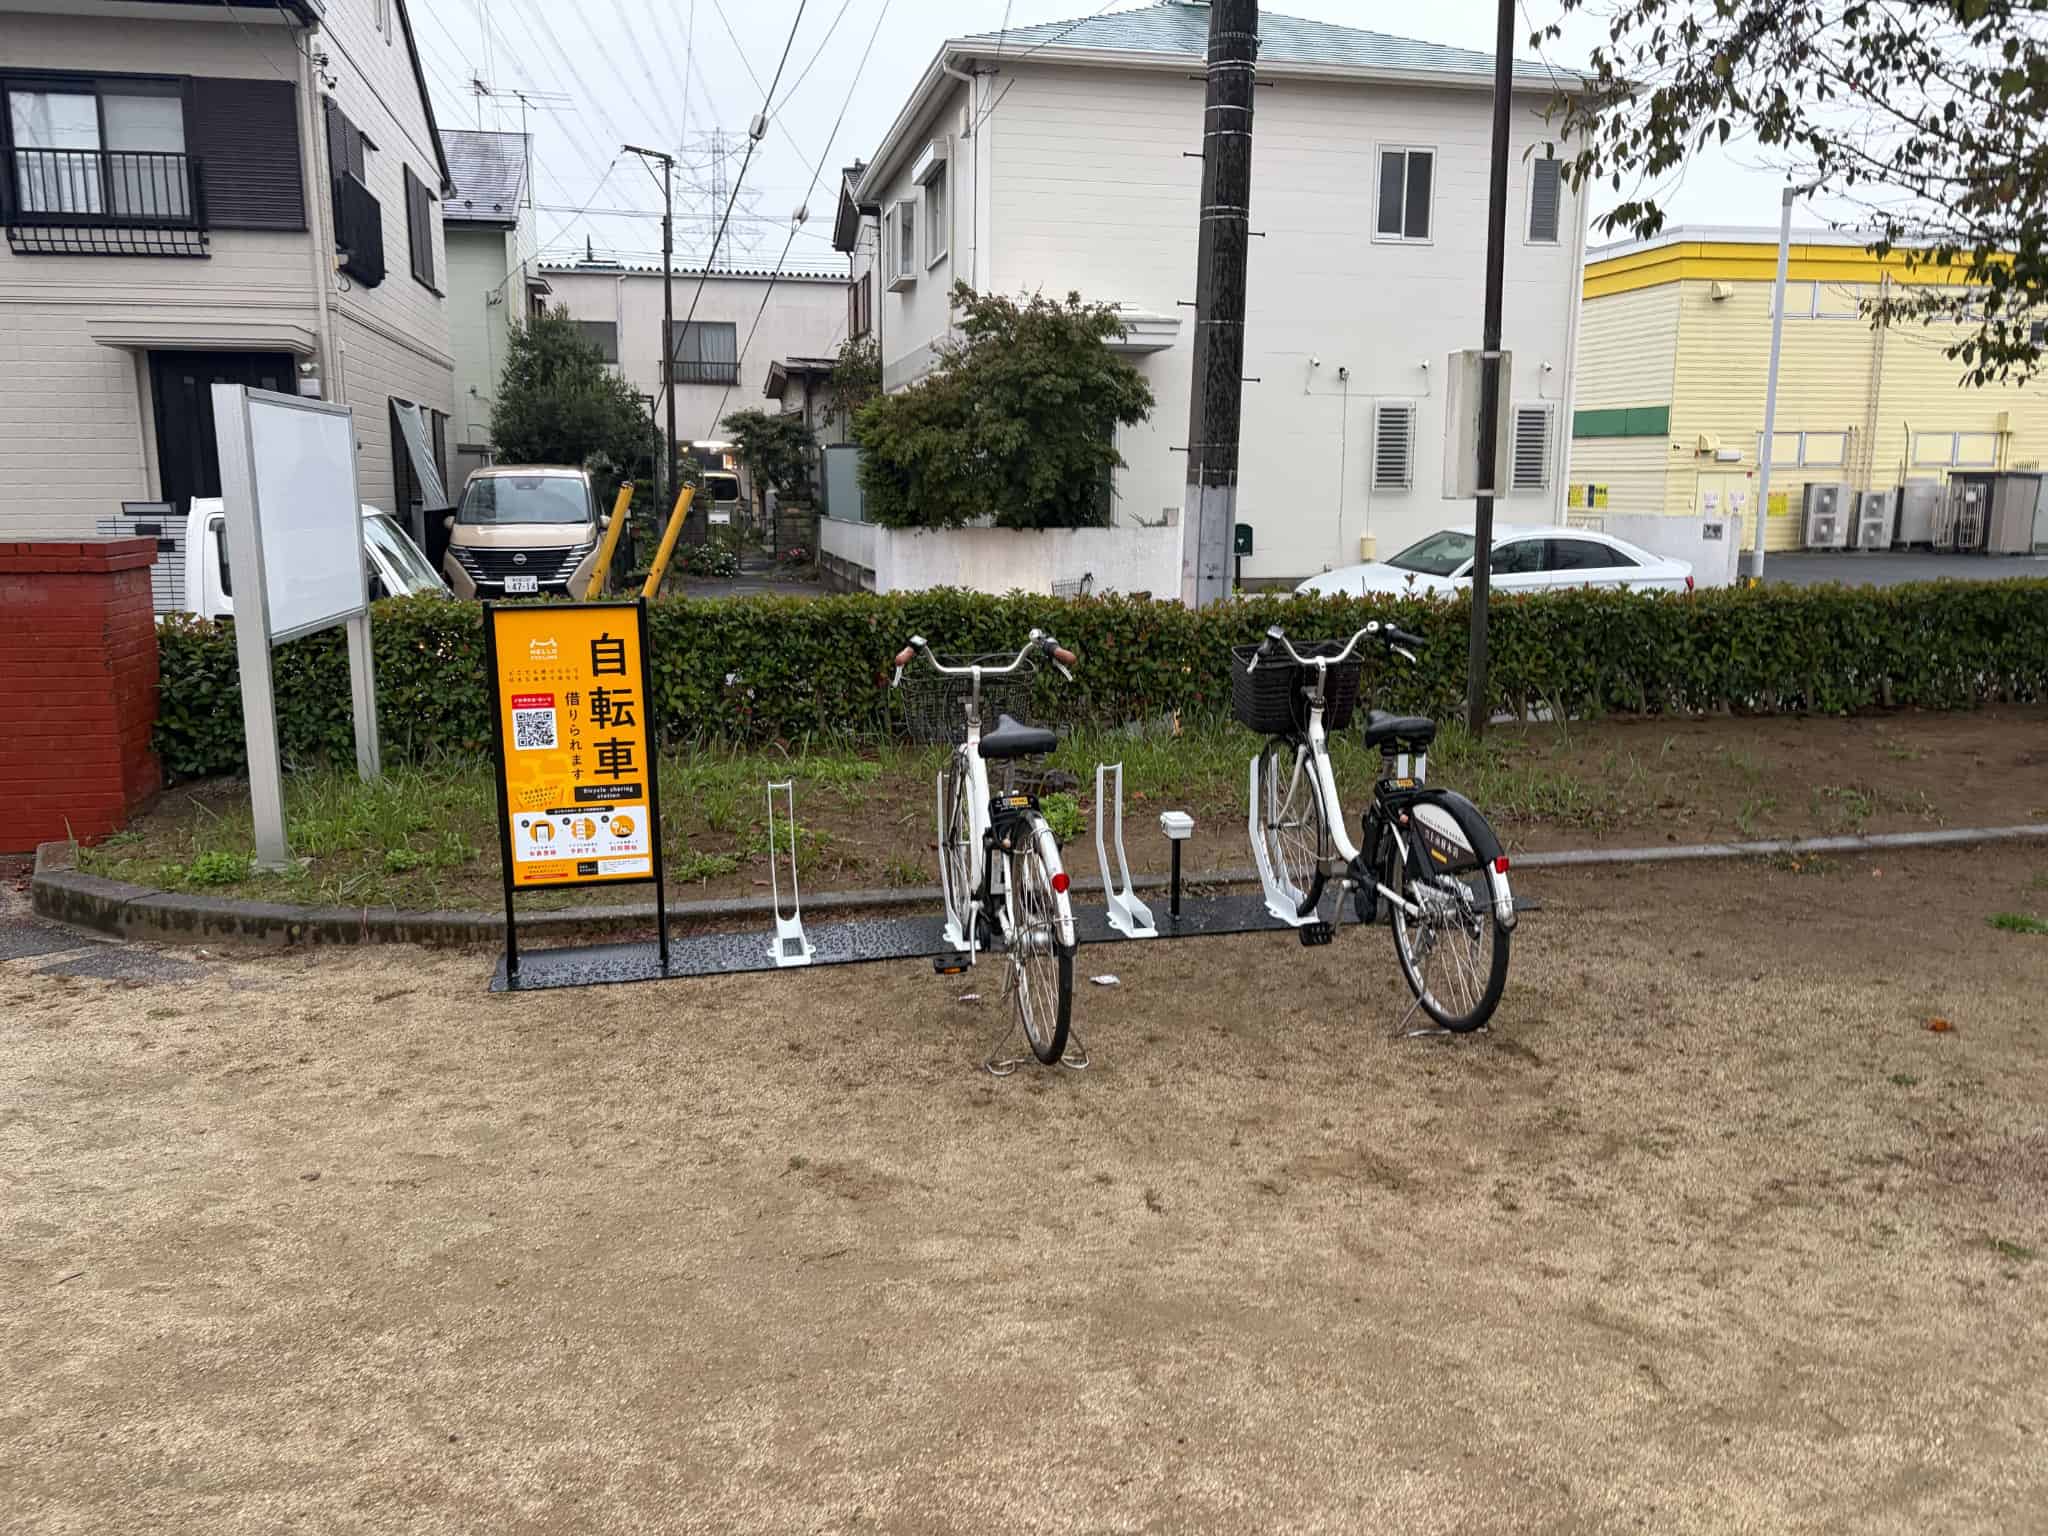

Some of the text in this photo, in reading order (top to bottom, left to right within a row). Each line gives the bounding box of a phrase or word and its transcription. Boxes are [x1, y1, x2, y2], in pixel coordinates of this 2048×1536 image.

[565, 692, 584, 780] 借りられます
[588, 633, 638, 779] 自転車
